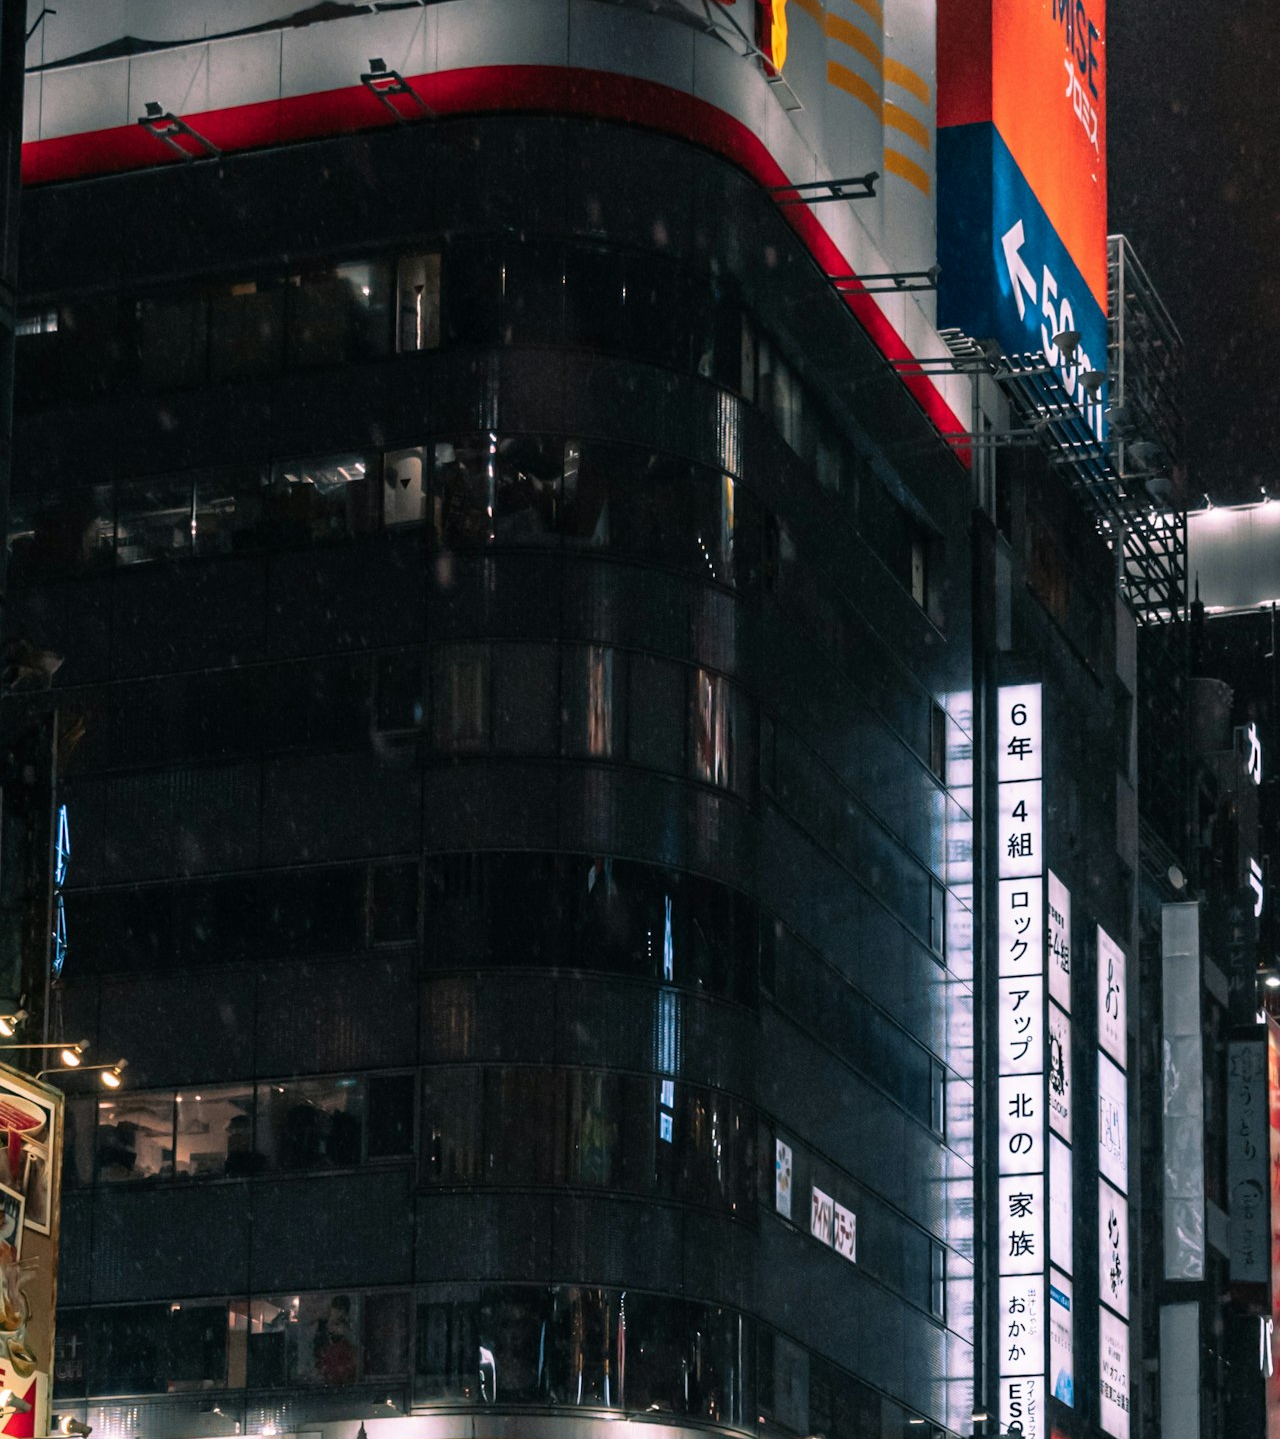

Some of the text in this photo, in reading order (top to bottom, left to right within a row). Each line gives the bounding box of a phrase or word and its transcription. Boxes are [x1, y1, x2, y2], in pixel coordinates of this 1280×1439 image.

[1064, 57, 1099, 153] プロミス
[1008, 889, 1034, 1062] ロックアップ
[1008, 1094, 1034, 1256] 北の家族
[1007, 1296, 1026, 1362] おかか
